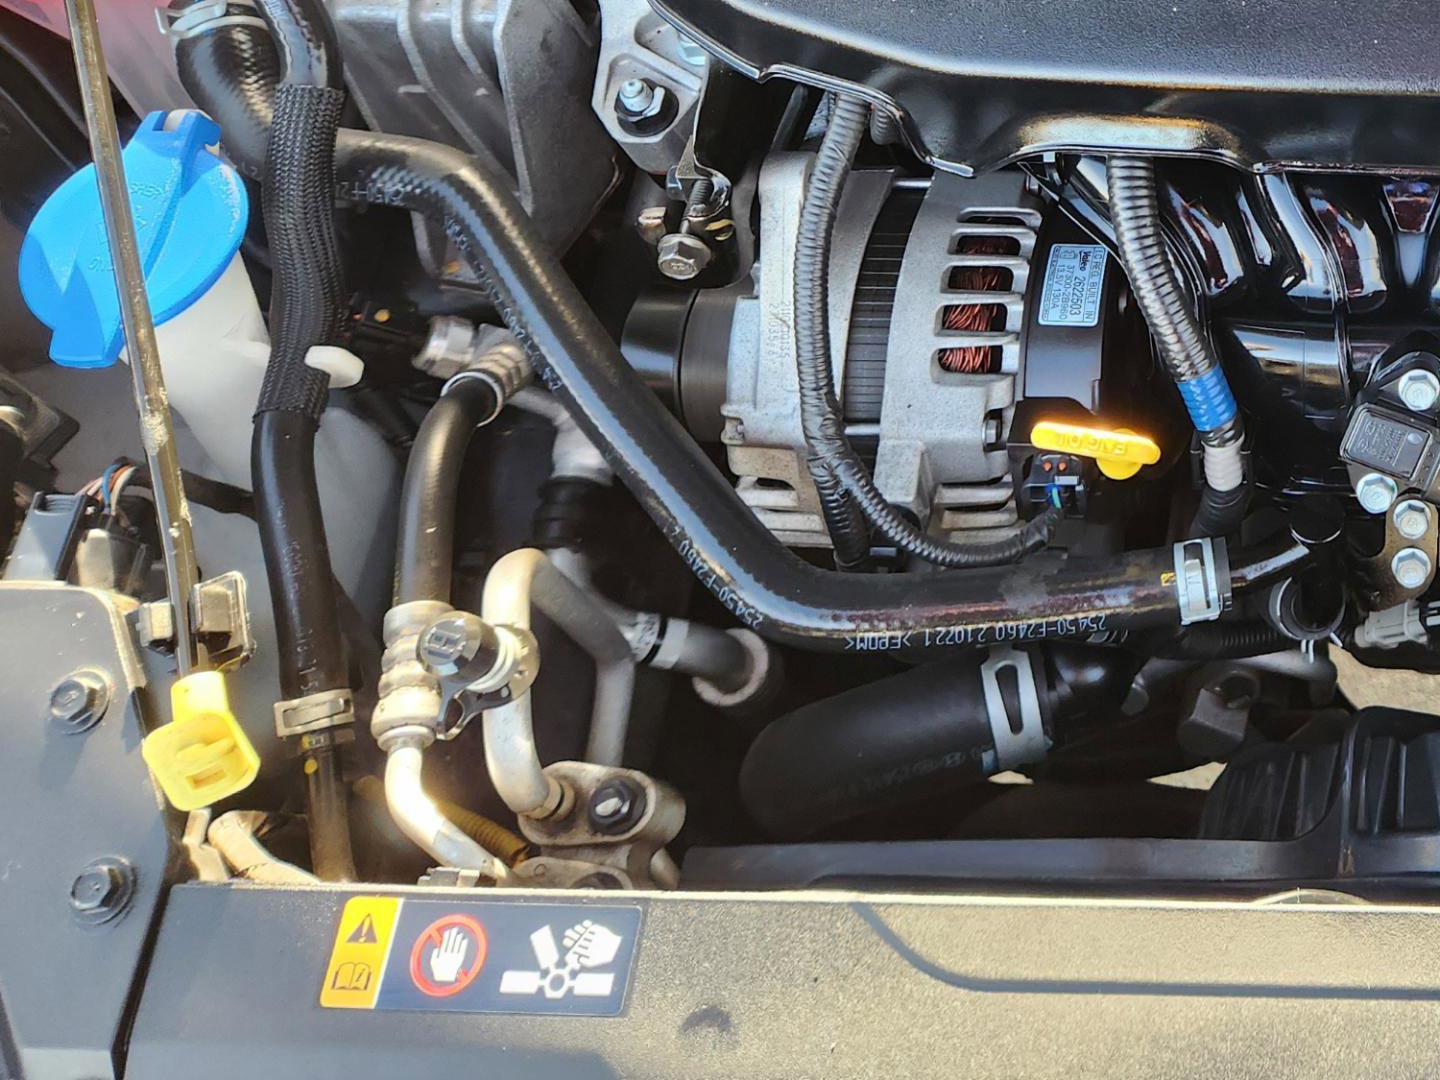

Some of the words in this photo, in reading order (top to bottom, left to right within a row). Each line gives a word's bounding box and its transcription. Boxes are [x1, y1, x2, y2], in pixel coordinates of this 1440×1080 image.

[1080, 250, 1092, 272] Valeo
[1051, 289, 1061, 309] 130A
[1070, 276, 1086, 316] 2622503
[1087, 281, 1097, 304] BUILT
[1084, 311, 1094, 320] IN
